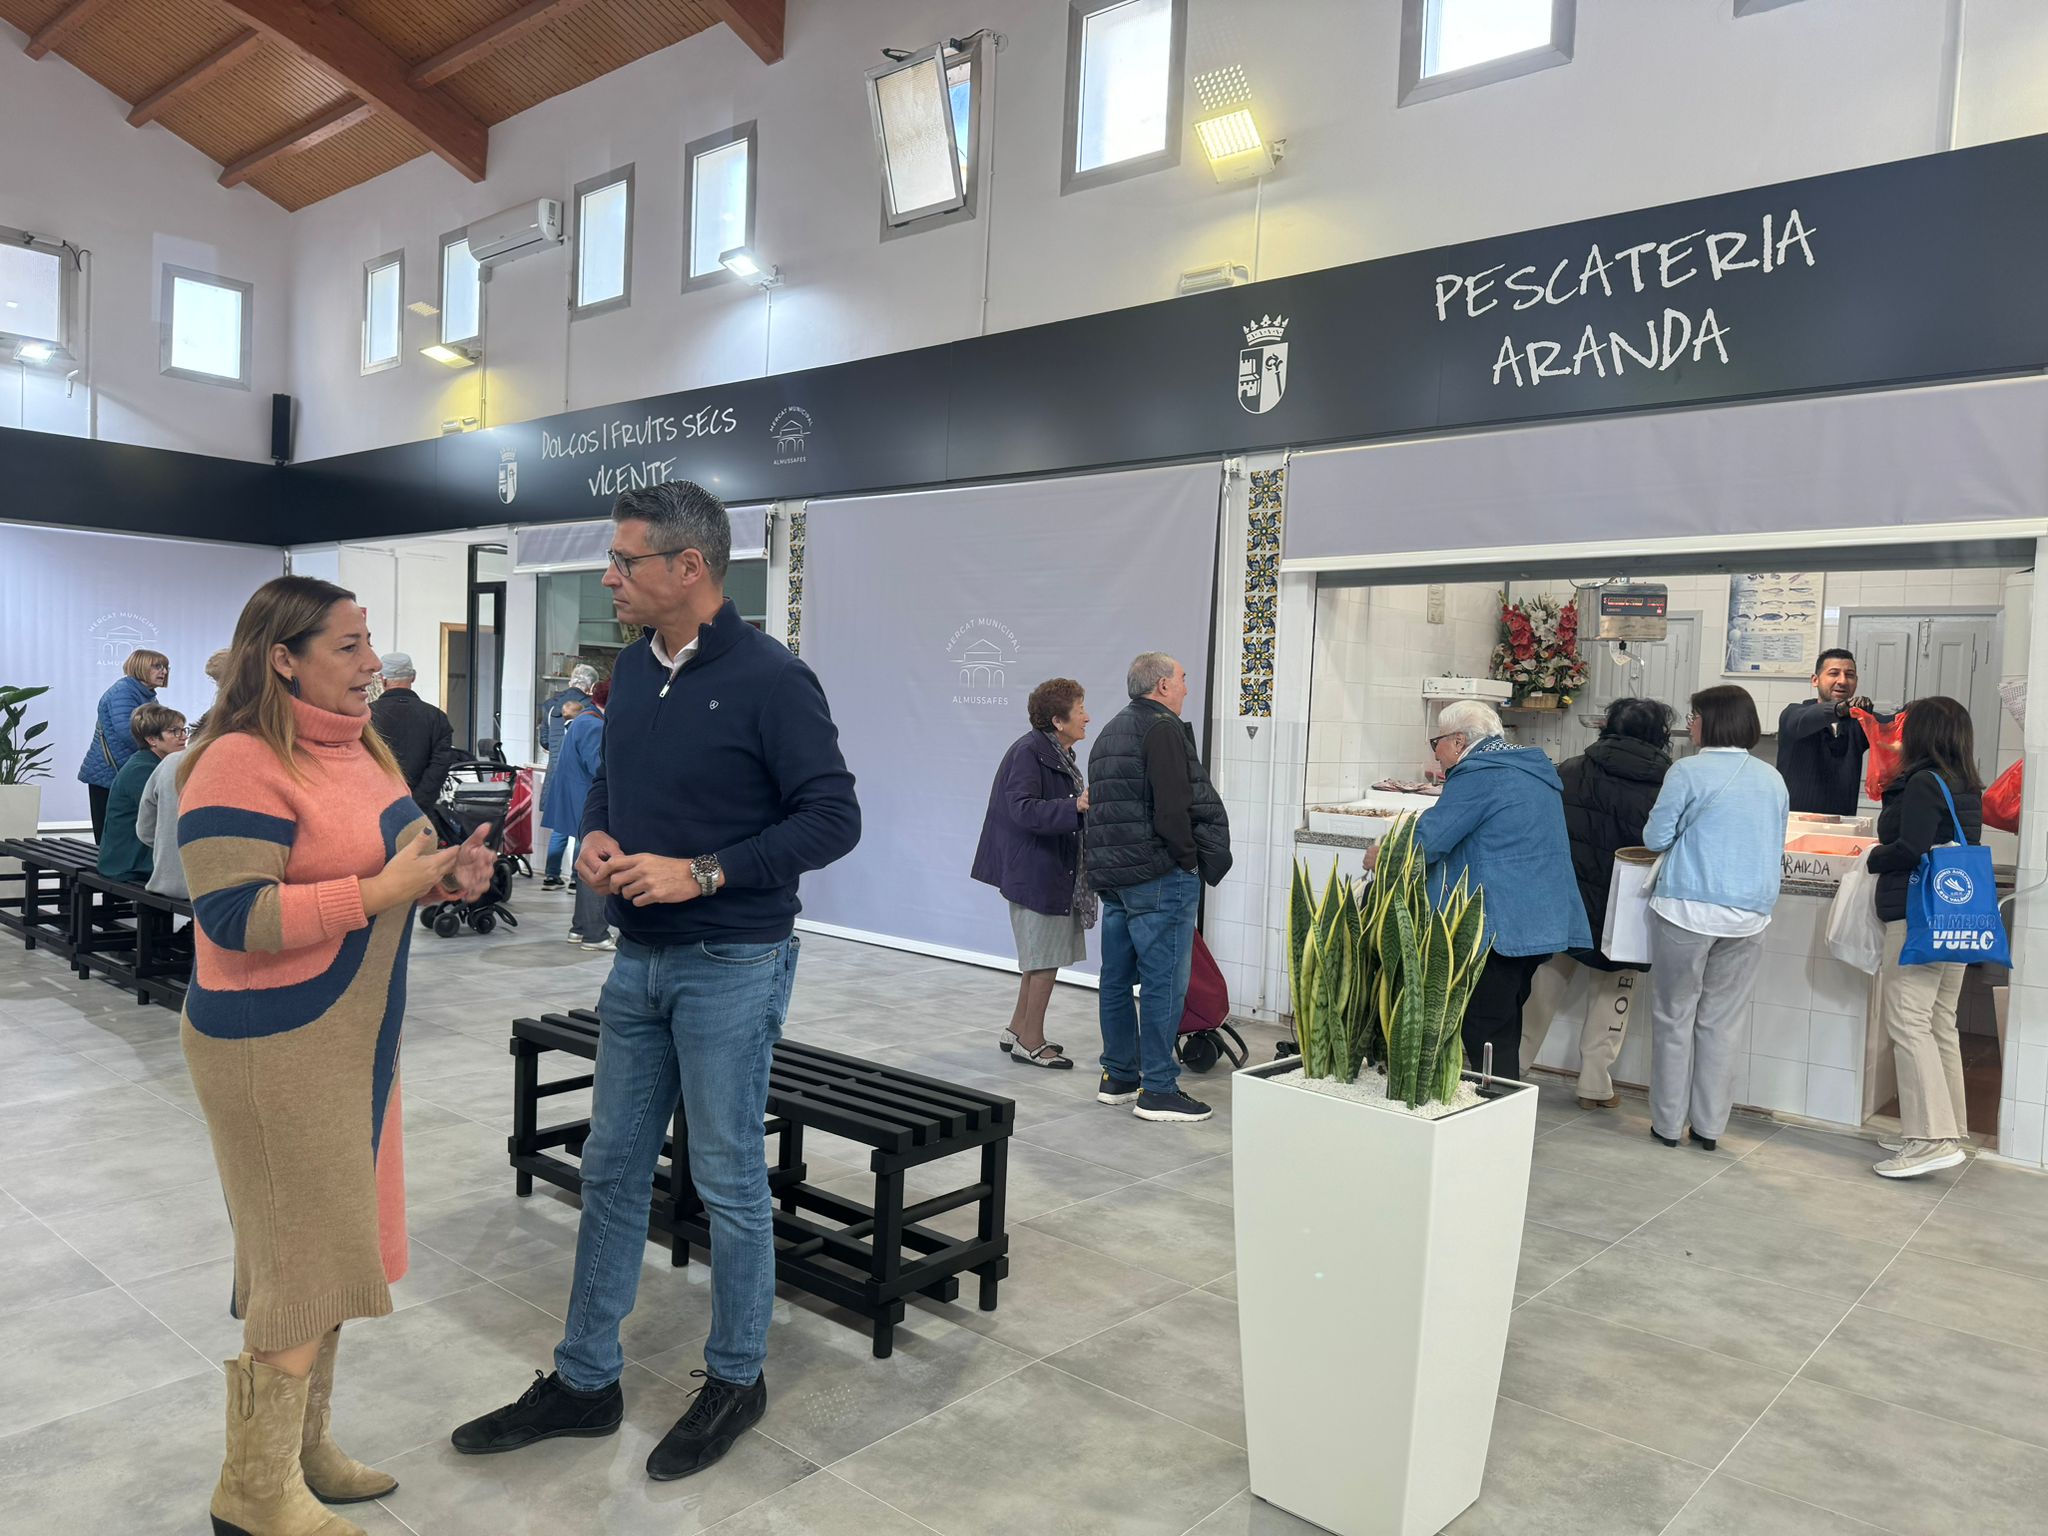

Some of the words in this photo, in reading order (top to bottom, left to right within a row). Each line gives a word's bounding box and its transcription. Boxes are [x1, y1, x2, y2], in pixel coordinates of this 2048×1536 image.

[1435, 209, 1817, 321] PESCATERIA
[1493, 308, 1731, 388] ARANDA
[542, 431, 599, 459] DOLÇOS
[611, 416, 677, 449] FRUITS
[682, 405, 737, 438] SECS
[588, 457, 677, 496] VICENTE
[945, 619, 975, 653] MERCAT
[978, 617, 1021, 653] MUNICIPAL
[952, 695, 1009, 705] ALMUSSAFES
